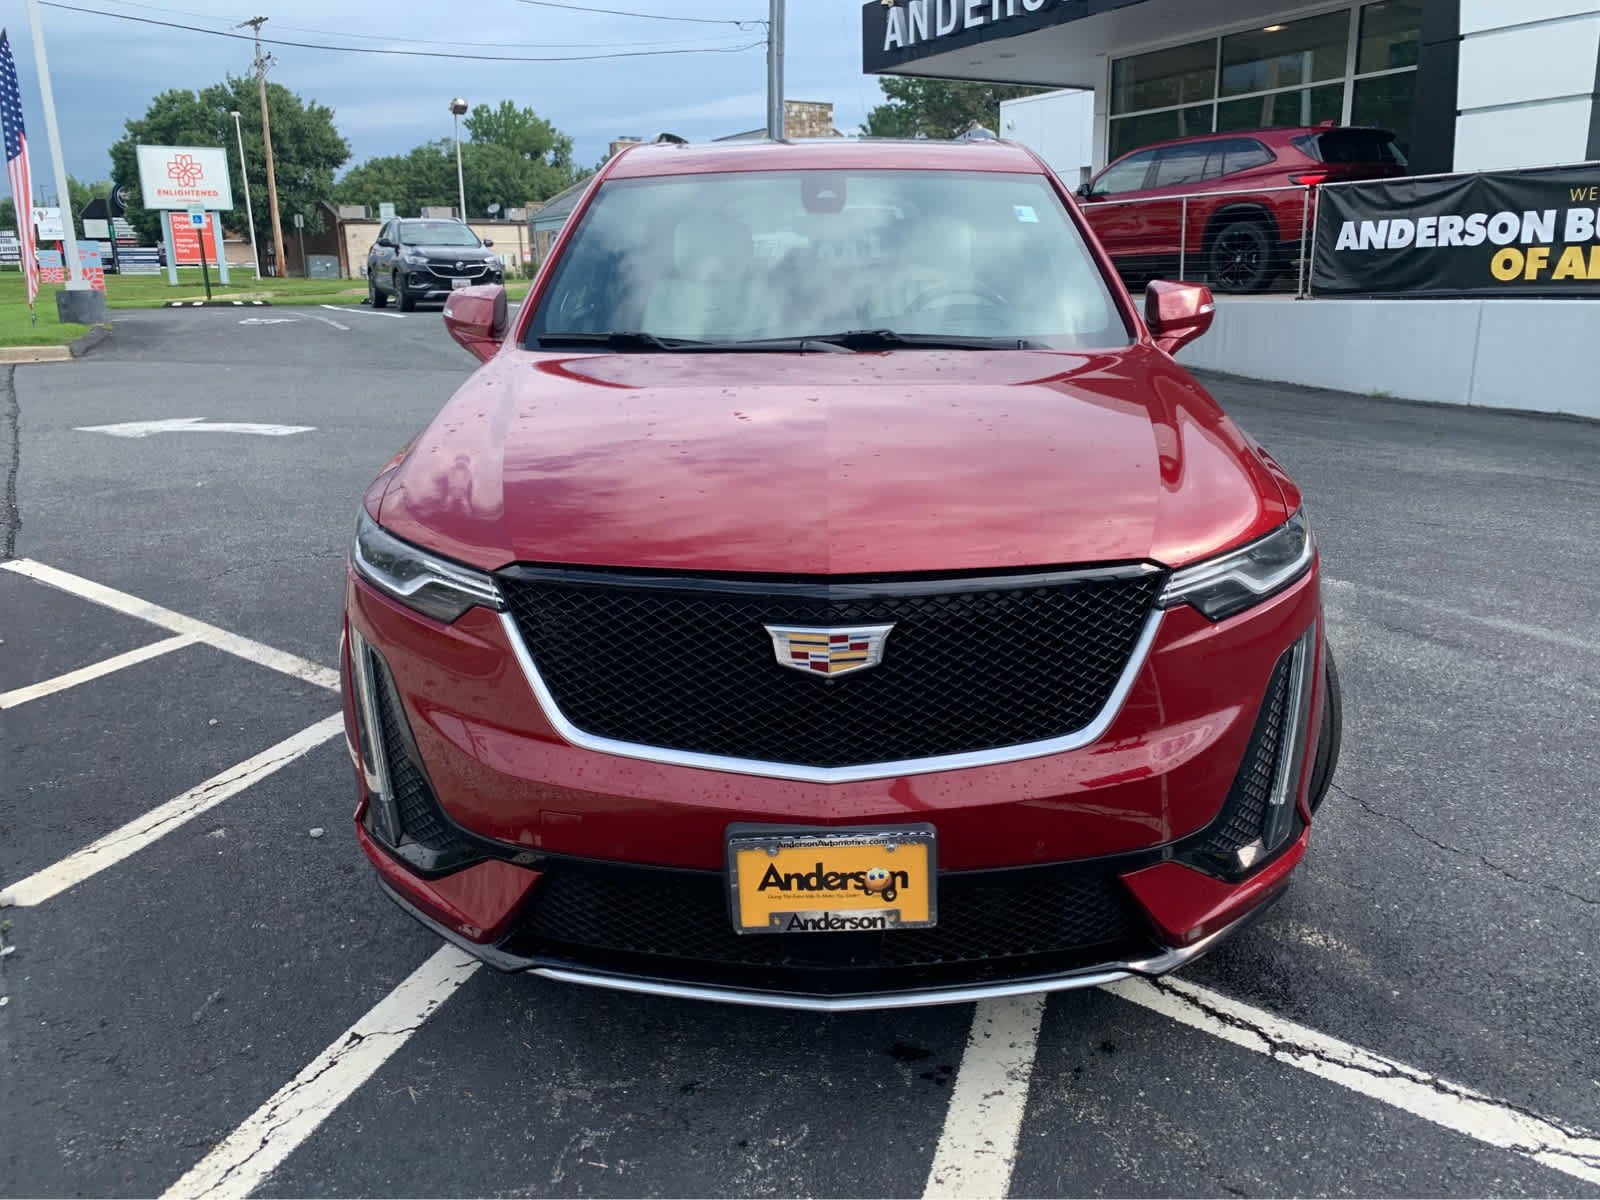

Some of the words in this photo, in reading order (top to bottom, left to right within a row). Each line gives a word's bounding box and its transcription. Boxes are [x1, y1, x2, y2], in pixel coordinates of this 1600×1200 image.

[156, 188, 219, 198] ENLIGHTENED
[1335, 208, 1557, 250] ANDERSON
[1564, 208, 1600, 243] B
[1490, 247, 1550, 281] OF
[776, 838, 888, 849] AndersonAutomotive.com
[757, 862, 909, 891] Anderson
[787, 911, 886, 932] Anderson
